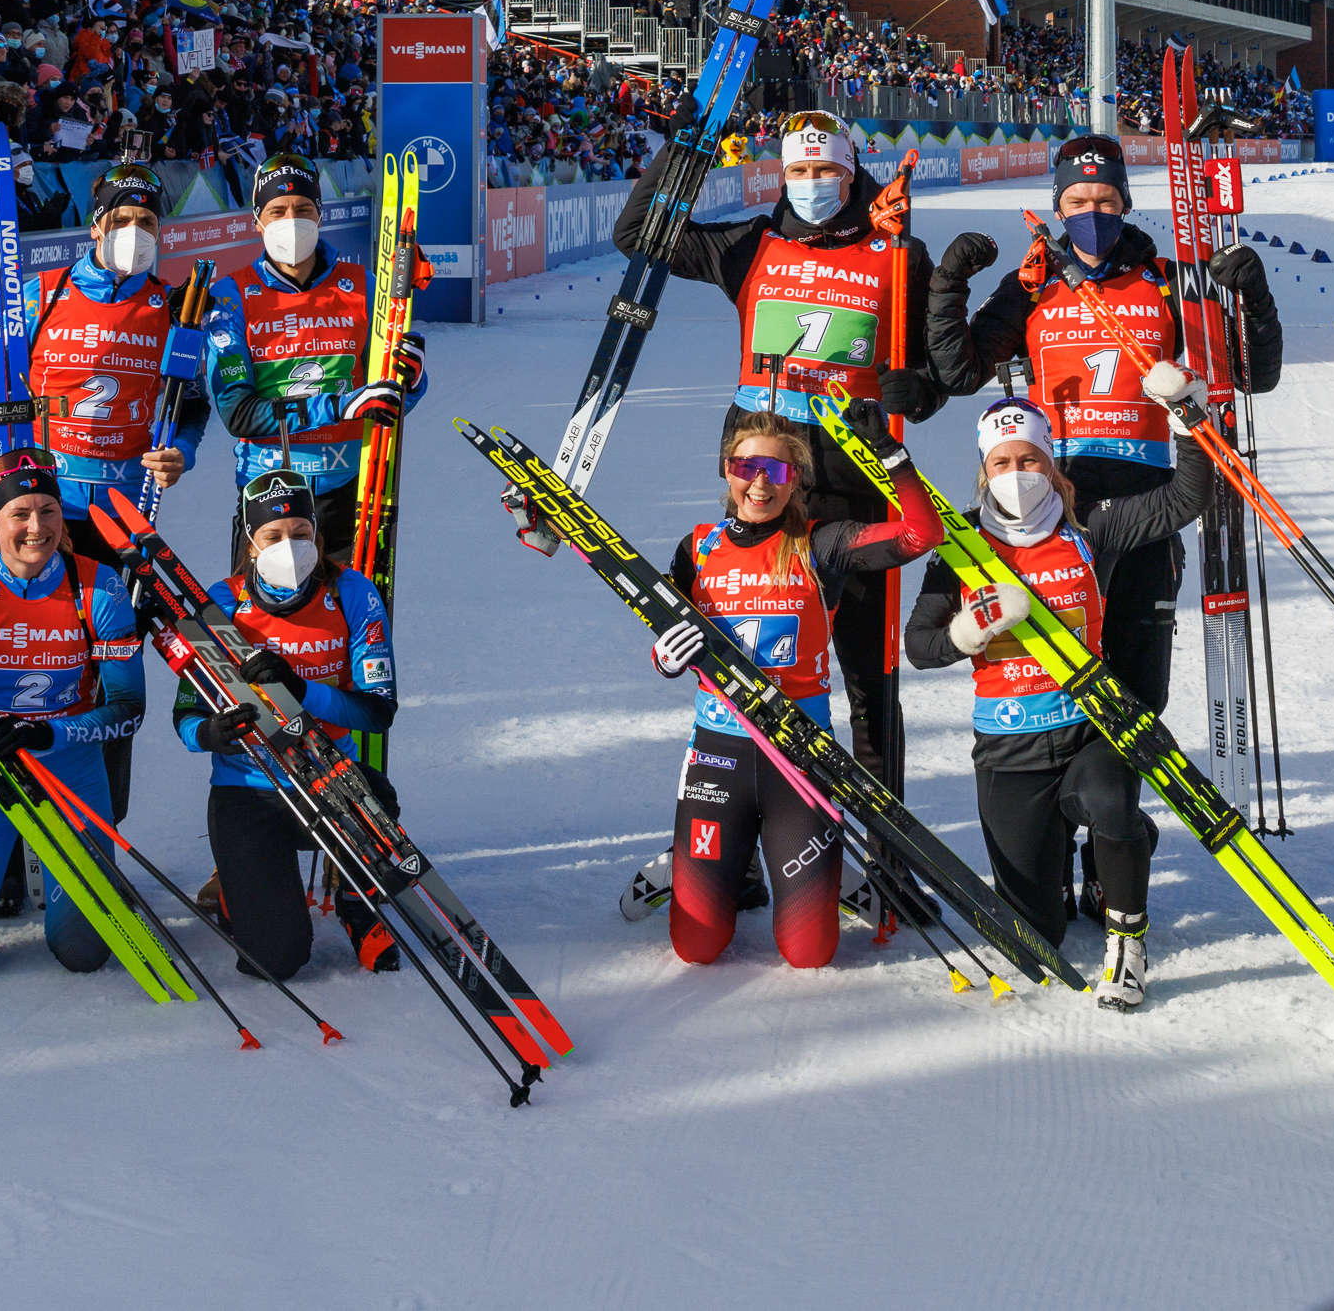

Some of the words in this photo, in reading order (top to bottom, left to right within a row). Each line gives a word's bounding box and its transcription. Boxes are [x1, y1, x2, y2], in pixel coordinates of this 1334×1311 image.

[390, 41, 466, 60] VIESSMANN
[1170, 142, 1192, 246] MADSHUS
[1190, 142, 1213, 245] MADSHUS
[492, 199, 537, 273] VIESSMANN
[548, 198, 591, 256] DECATHLON
[30, 243, 69, 266] DECATHLON.de
[1, 220, 24, 337] SALOMON
[375, 215, 394, 341] FISCHER
[767, 260, 880, 289] VIESSMANN
[757, 284, 782, 296] for
[784, 287, 813, 299] our
[817, 288, 879, 310] climate
[47, 323, 157, 349] VIESSMANN
[250, 312, 354, 339] VIESSMANN
[796, 310, 833, 354] 1
[1039, 329, 1064, 343] for
[1066, 330, 1094, 341] our
[43, 349, 65, 363] for
[69, 353, 98, 365] our
[102, 351, 157, 371] climate
[171, 351, 198, 361] SALOMON
[250, 345, 273, 358] for
[275, 341, 302, 354] our
[304, 337, 356, 353] climate
[848, 337, 869, 361] 2
[220, 360, 247, 379] mgen
[787, 362, 848, 384] Otepää
[1083, 348, 1122, 395] 1
[71, 374, 120, 420] 2
[128, 398, 142, 421] 1
[1083, 407, 1139, 424] Otepää
[1070, 425, 1092, 436] visit
[1093, 425, 1131, 436] estonia
[291, 460, 321, 472] THE
[489, 447, 602, 554] FISCHER
[525, 455, 639, 562] FISCHER
[173, 562, 208, 604] ROSSIGNOL
[153, 577, 187, 620] ROSSIGNOL
[698, 598, 712, 613] for
[715, 599, 741, 611] our
[744, 595, 805, 611] climate
[1217, 598, 1246, 607] MADSHUS
[731, 618, 762, 662] 1
[770, 634, 794, 661] 4
[23, 649, 90, 666] climate
[1013, 682, 1031, 693] visit
[1070, 659, 1103, 693] FISCHER
[12, 672, 53, 709] 2
[56, 682, 75, 704] 4
[66, 714, 143, 743] FRANCE
[1030, 710, 1061, 726] THE
[1216, 699, 1226, 759] REDLINE
[1236, 697, 1246, 756] REDLINE
[698, 754, 732, 768] LAPUA
